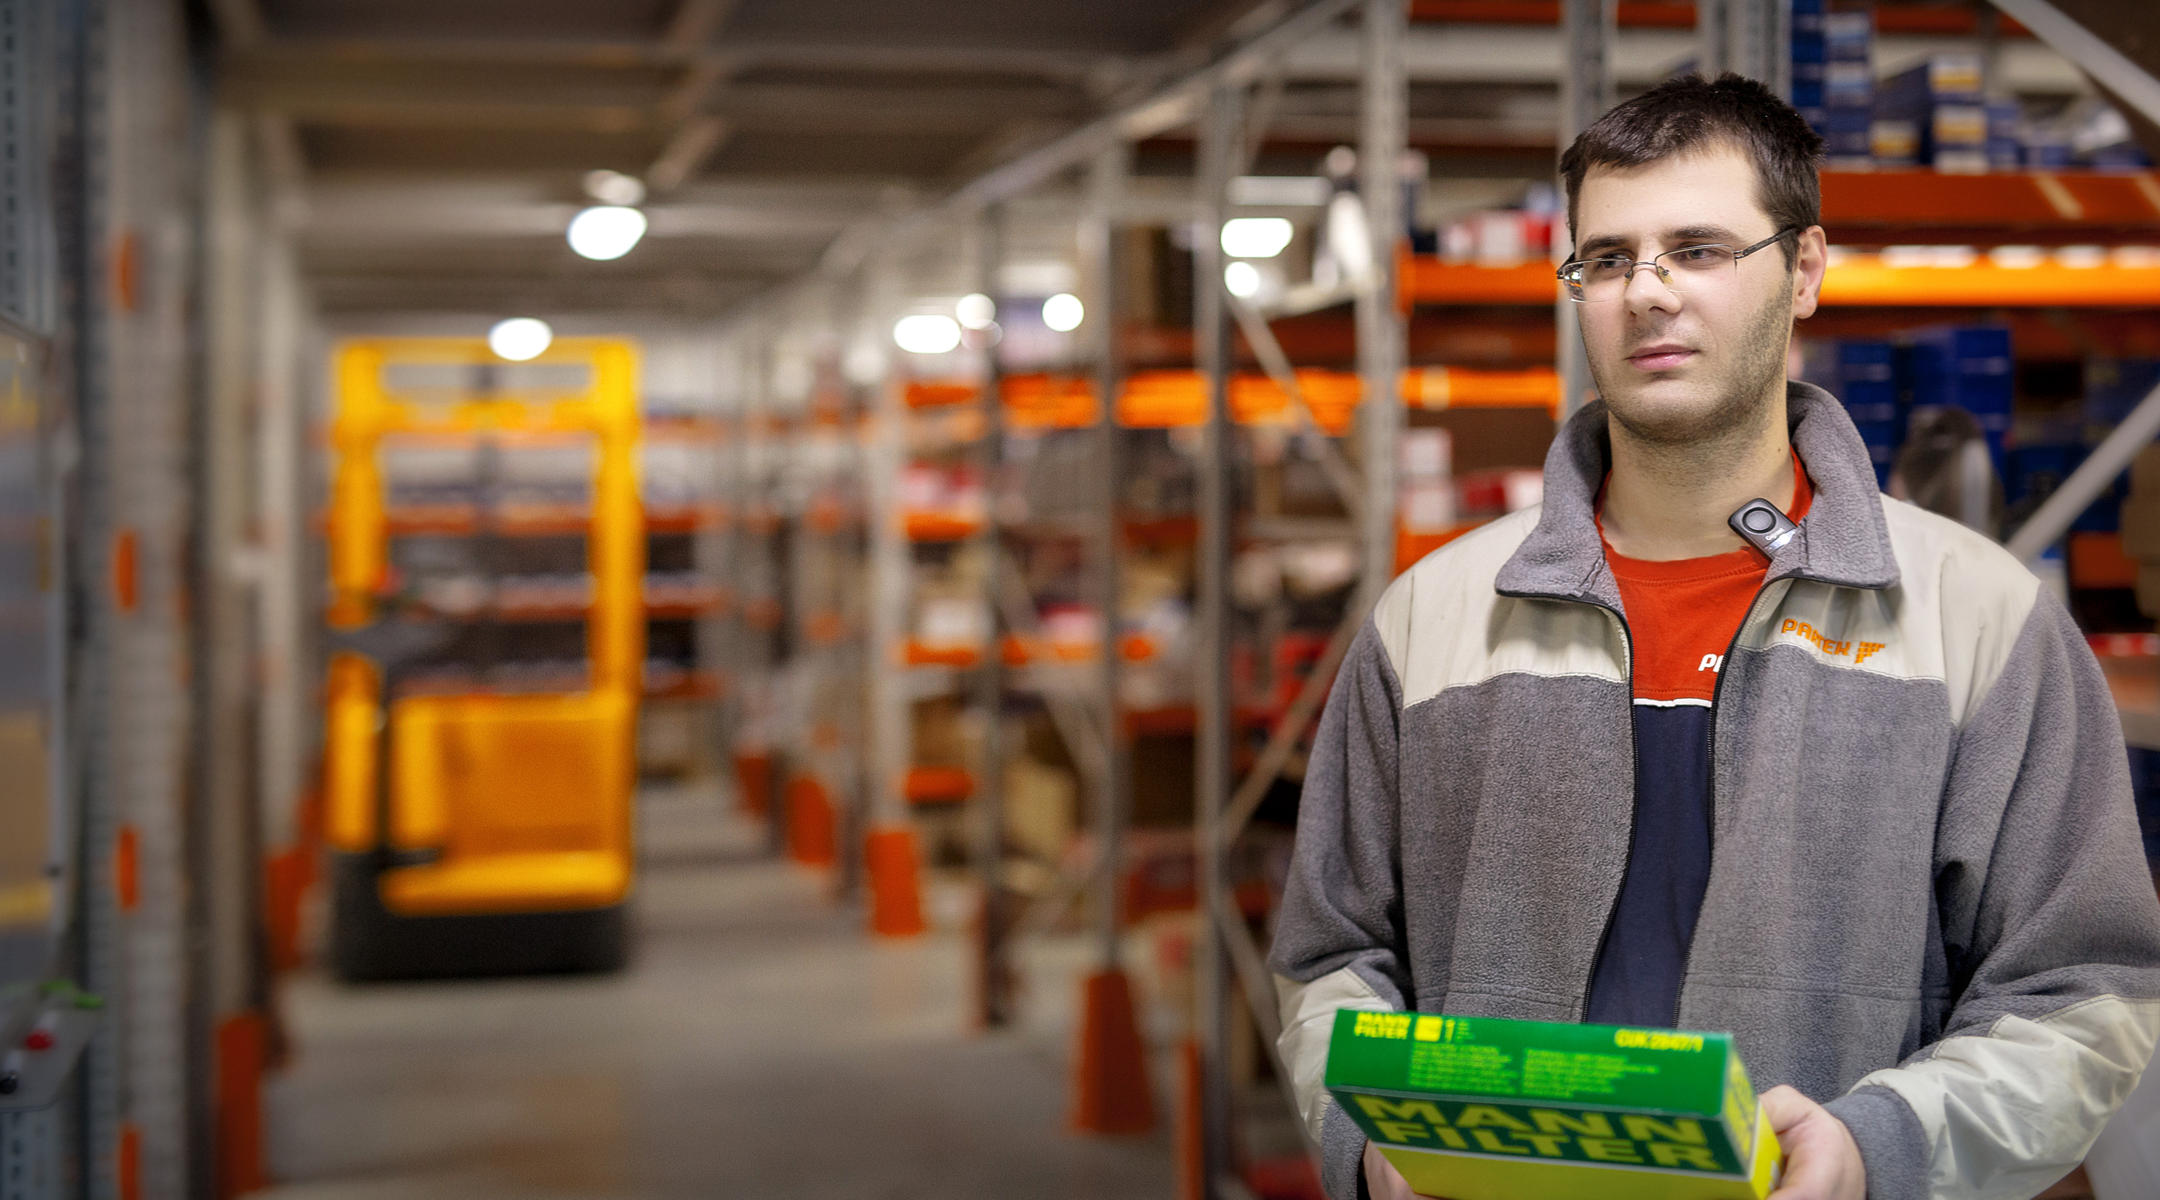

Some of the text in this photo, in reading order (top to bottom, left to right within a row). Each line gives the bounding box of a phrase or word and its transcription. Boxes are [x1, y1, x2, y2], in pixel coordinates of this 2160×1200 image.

[1354, 1025, 1407, 1040] FILTER
[1357, 1011, 1411, 1026] MANN
[1354, 1096, 1707, 1144] MANN
[1376, 1122, 1722, 1170] FILTER
